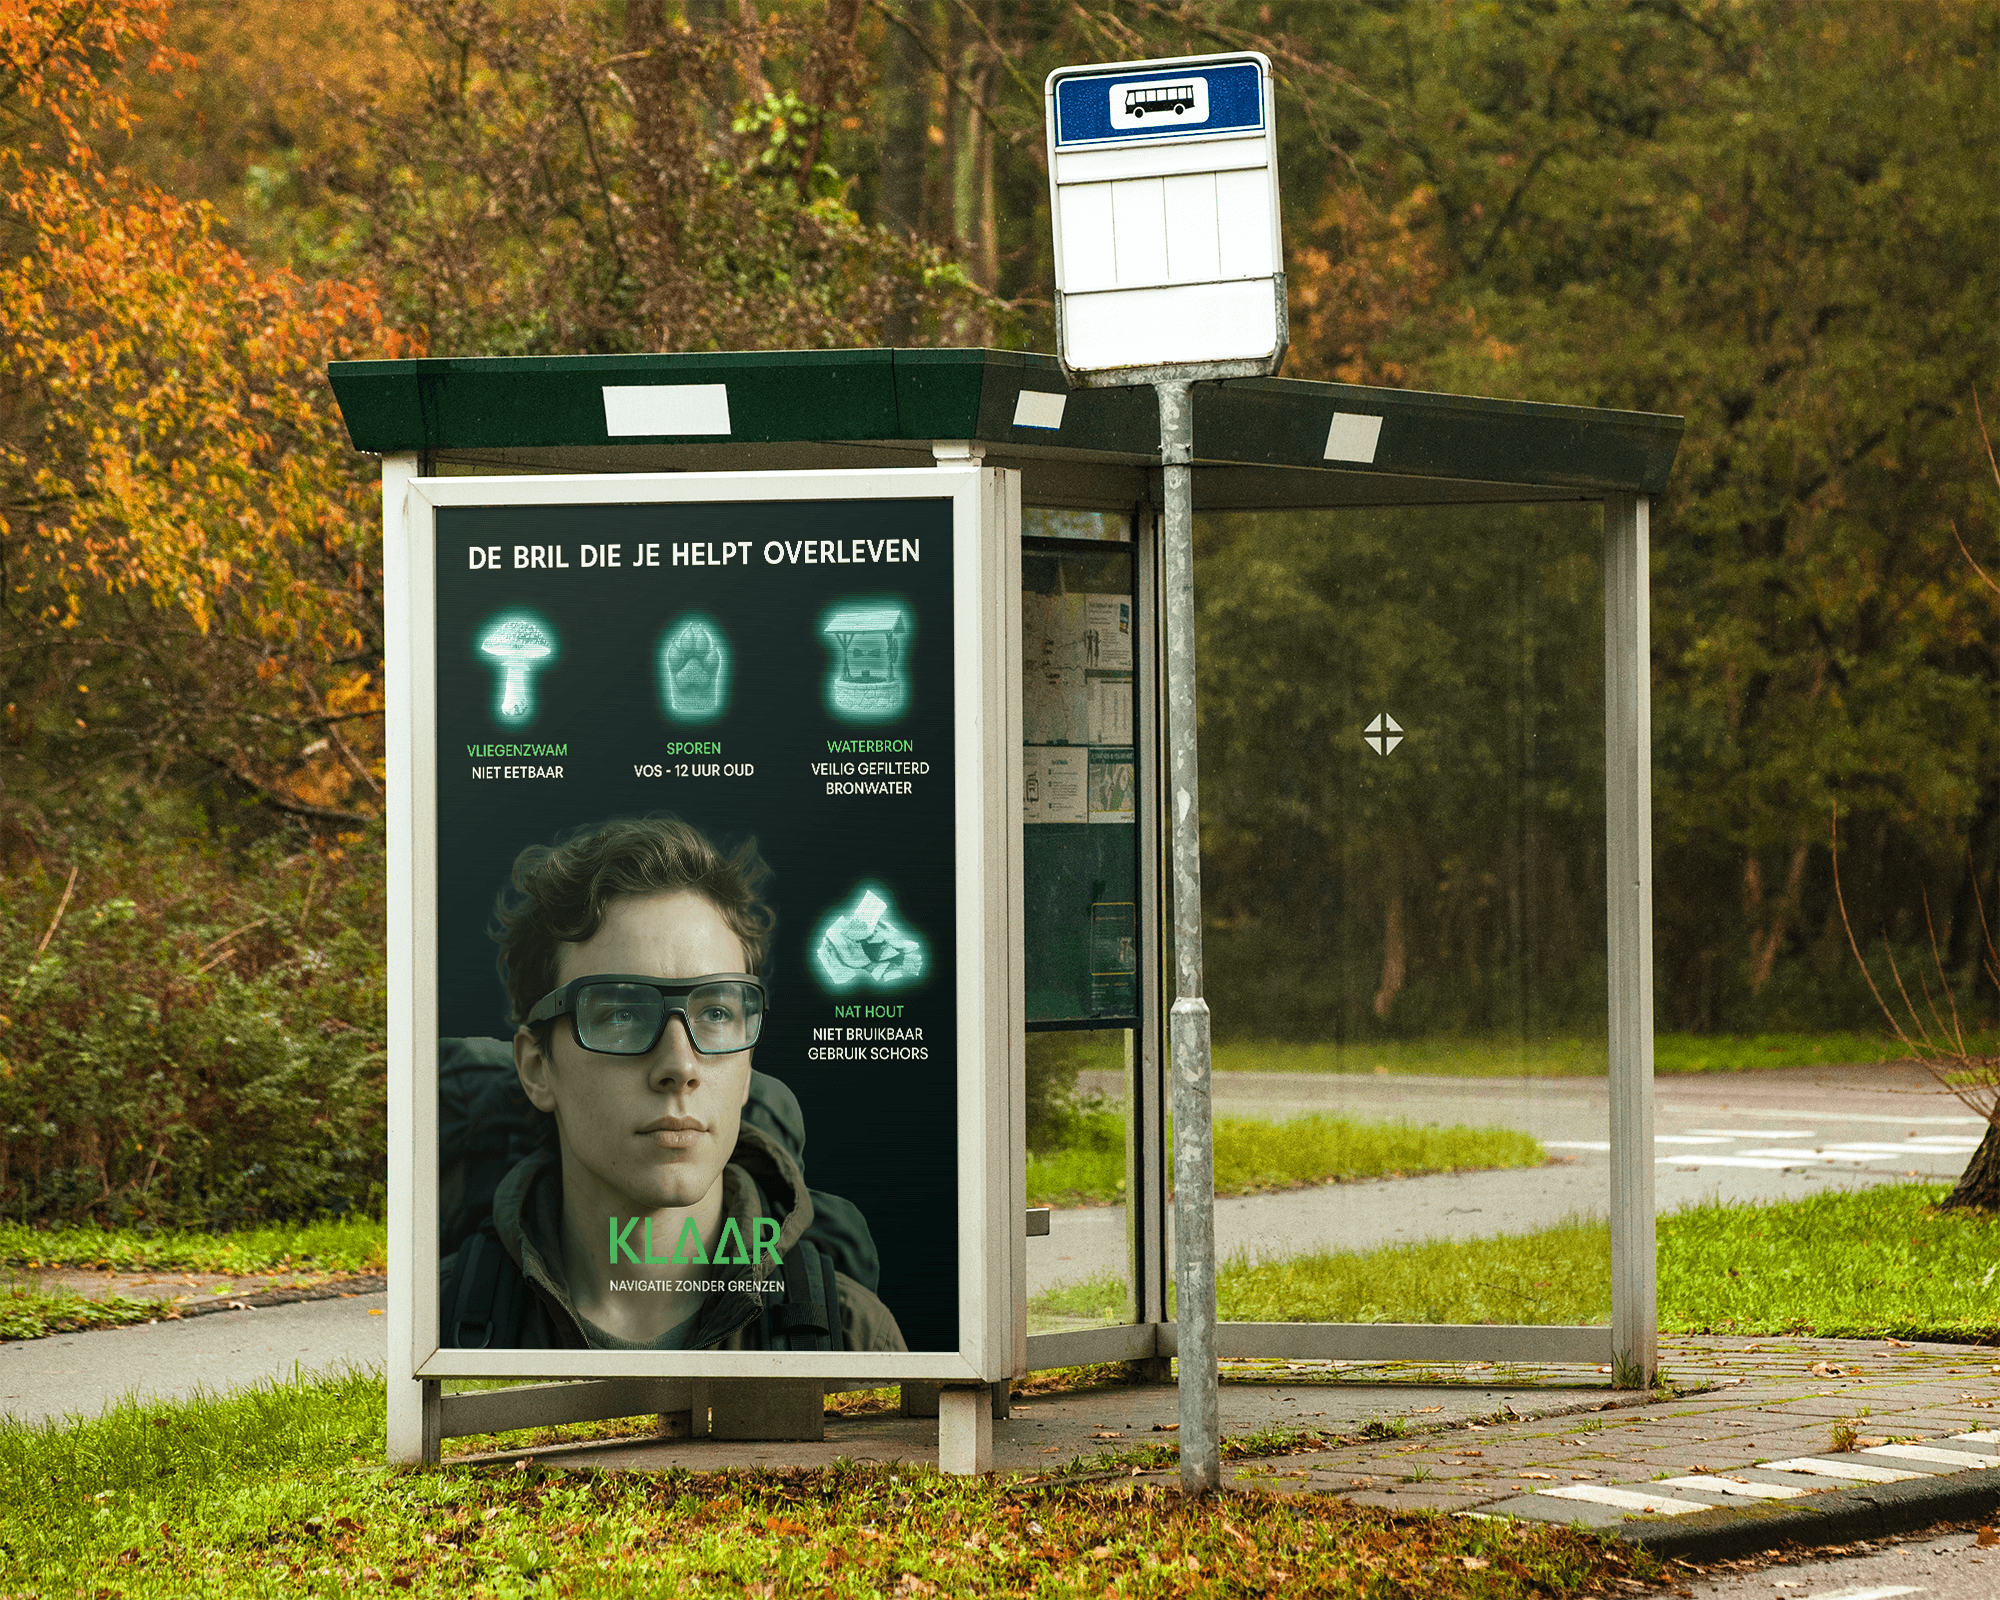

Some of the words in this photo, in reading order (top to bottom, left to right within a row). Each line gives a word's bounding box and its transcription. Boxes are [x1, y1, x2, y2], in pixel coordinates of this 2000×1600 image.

[468, 545, 501, 570] DE
[514, 545, 569, 569] BRIL
[580, 544, 621, 568] DIE
[632, 543, 660, 567] JE
[672, 541, 752, 566] HELPT
[764, 539, 920, 565] OVERLEVEN
[467, 744, 568, 758] VLIEGENZWAM
[666, 742, 721, 755] SPOREN
[827, 740, 913, 754] WATERBRON
[472, 766, 501, 780] NIET
[504, 766, 564, 779] EETBAAR
[634, 765, 662, 778] VOS
[674, 764, 688, 777] 12
[691, 764, 720, 777] UUR
[723, 764, 755, 777] OUD
[811, 763, 854, 776] VEILIG
[857, 762, 930, 775] GEFILTERD
[826, 781, 913, 795] BRONWATER
[835, 1005, 862, 1018] NAT
[865, 1005, 905, 1018] HOUT
[813, 1027, 843, 1041] NIET
[846, 1027, 924, 1041] BRUIKBAAR
[807, 1047, 868, 1060] GEBRUIK
[870, 1047, 929, 1060] SCHORS
[609, 1216, 784, 1265] KLAAR
[609, 1280, 673, 1292] NAVIGATIE
[675, 1280, 726, 1292] ZONDER
[728, 1280, 785, 1293] GRENZEN
